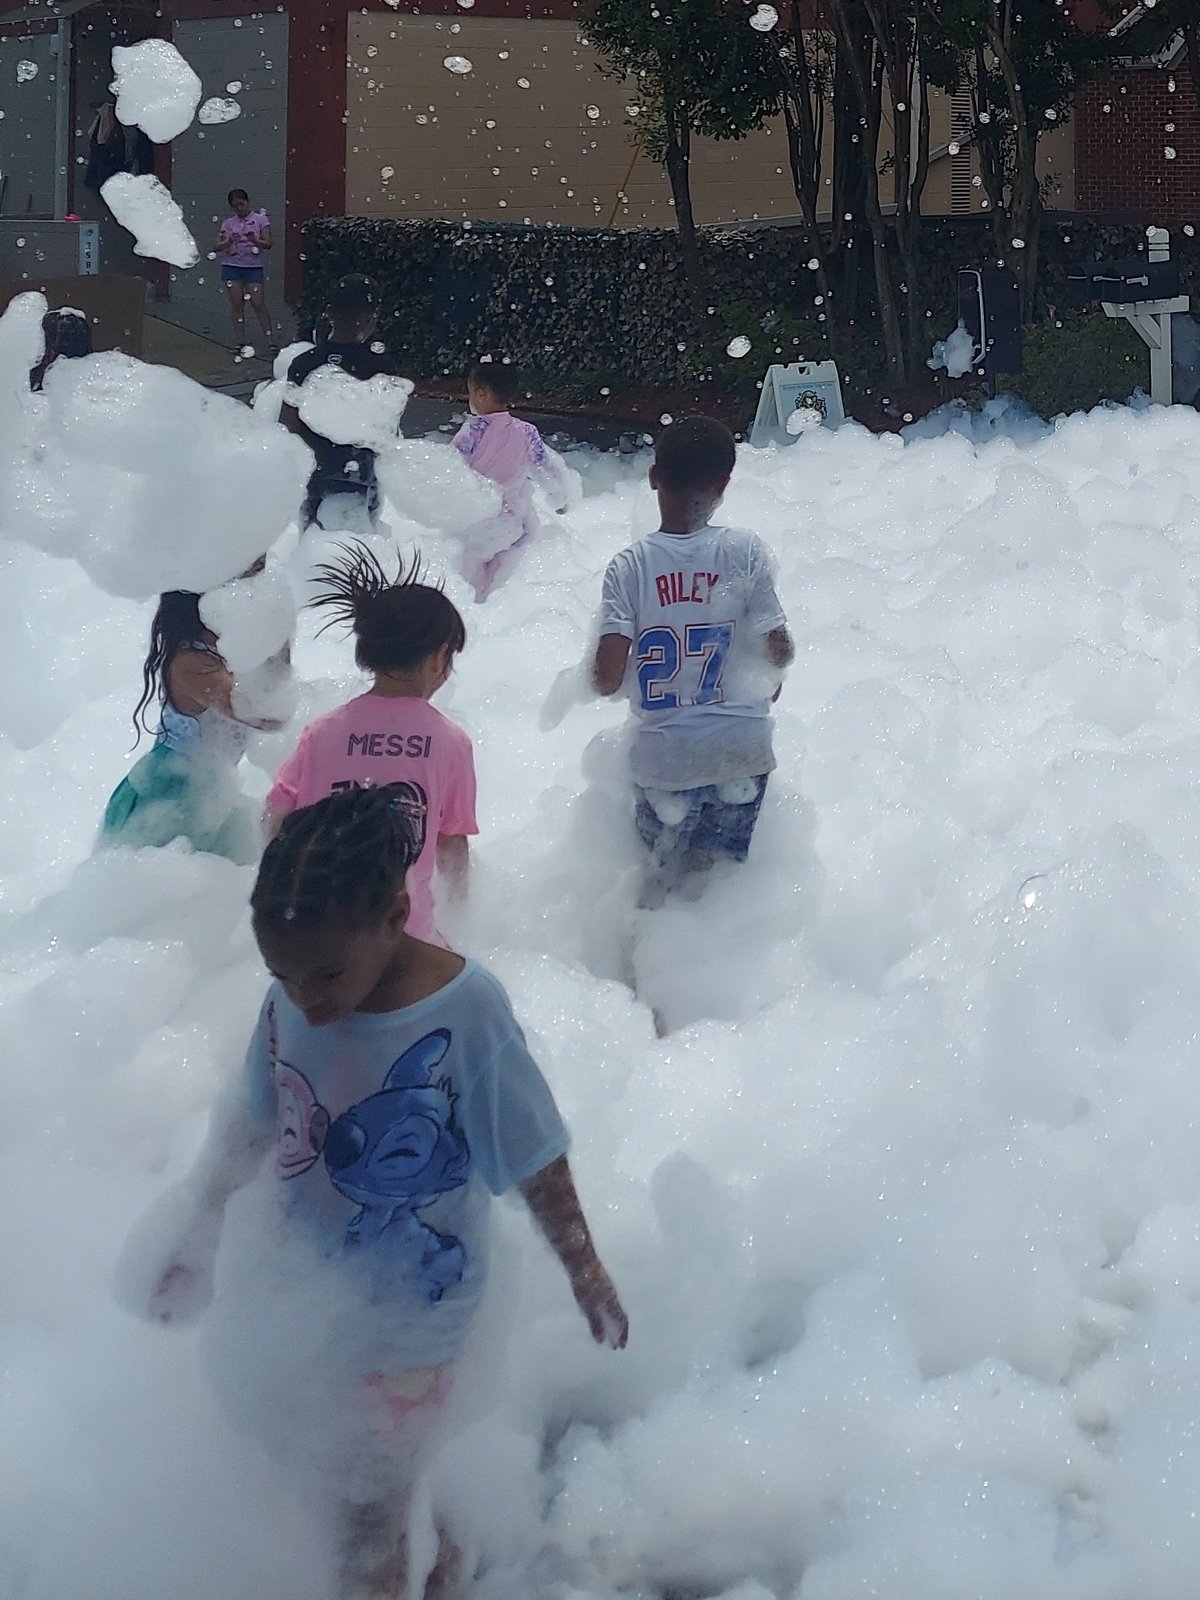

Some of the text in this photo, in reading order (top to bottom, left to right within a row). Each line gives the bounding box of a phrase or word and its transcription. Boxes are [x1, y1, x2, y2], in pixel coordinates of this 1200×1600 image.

[655, 571, 720, 607] RILEY
[636, 619, 736, 711] 27
[347, 732, 432, 758] MESSI
